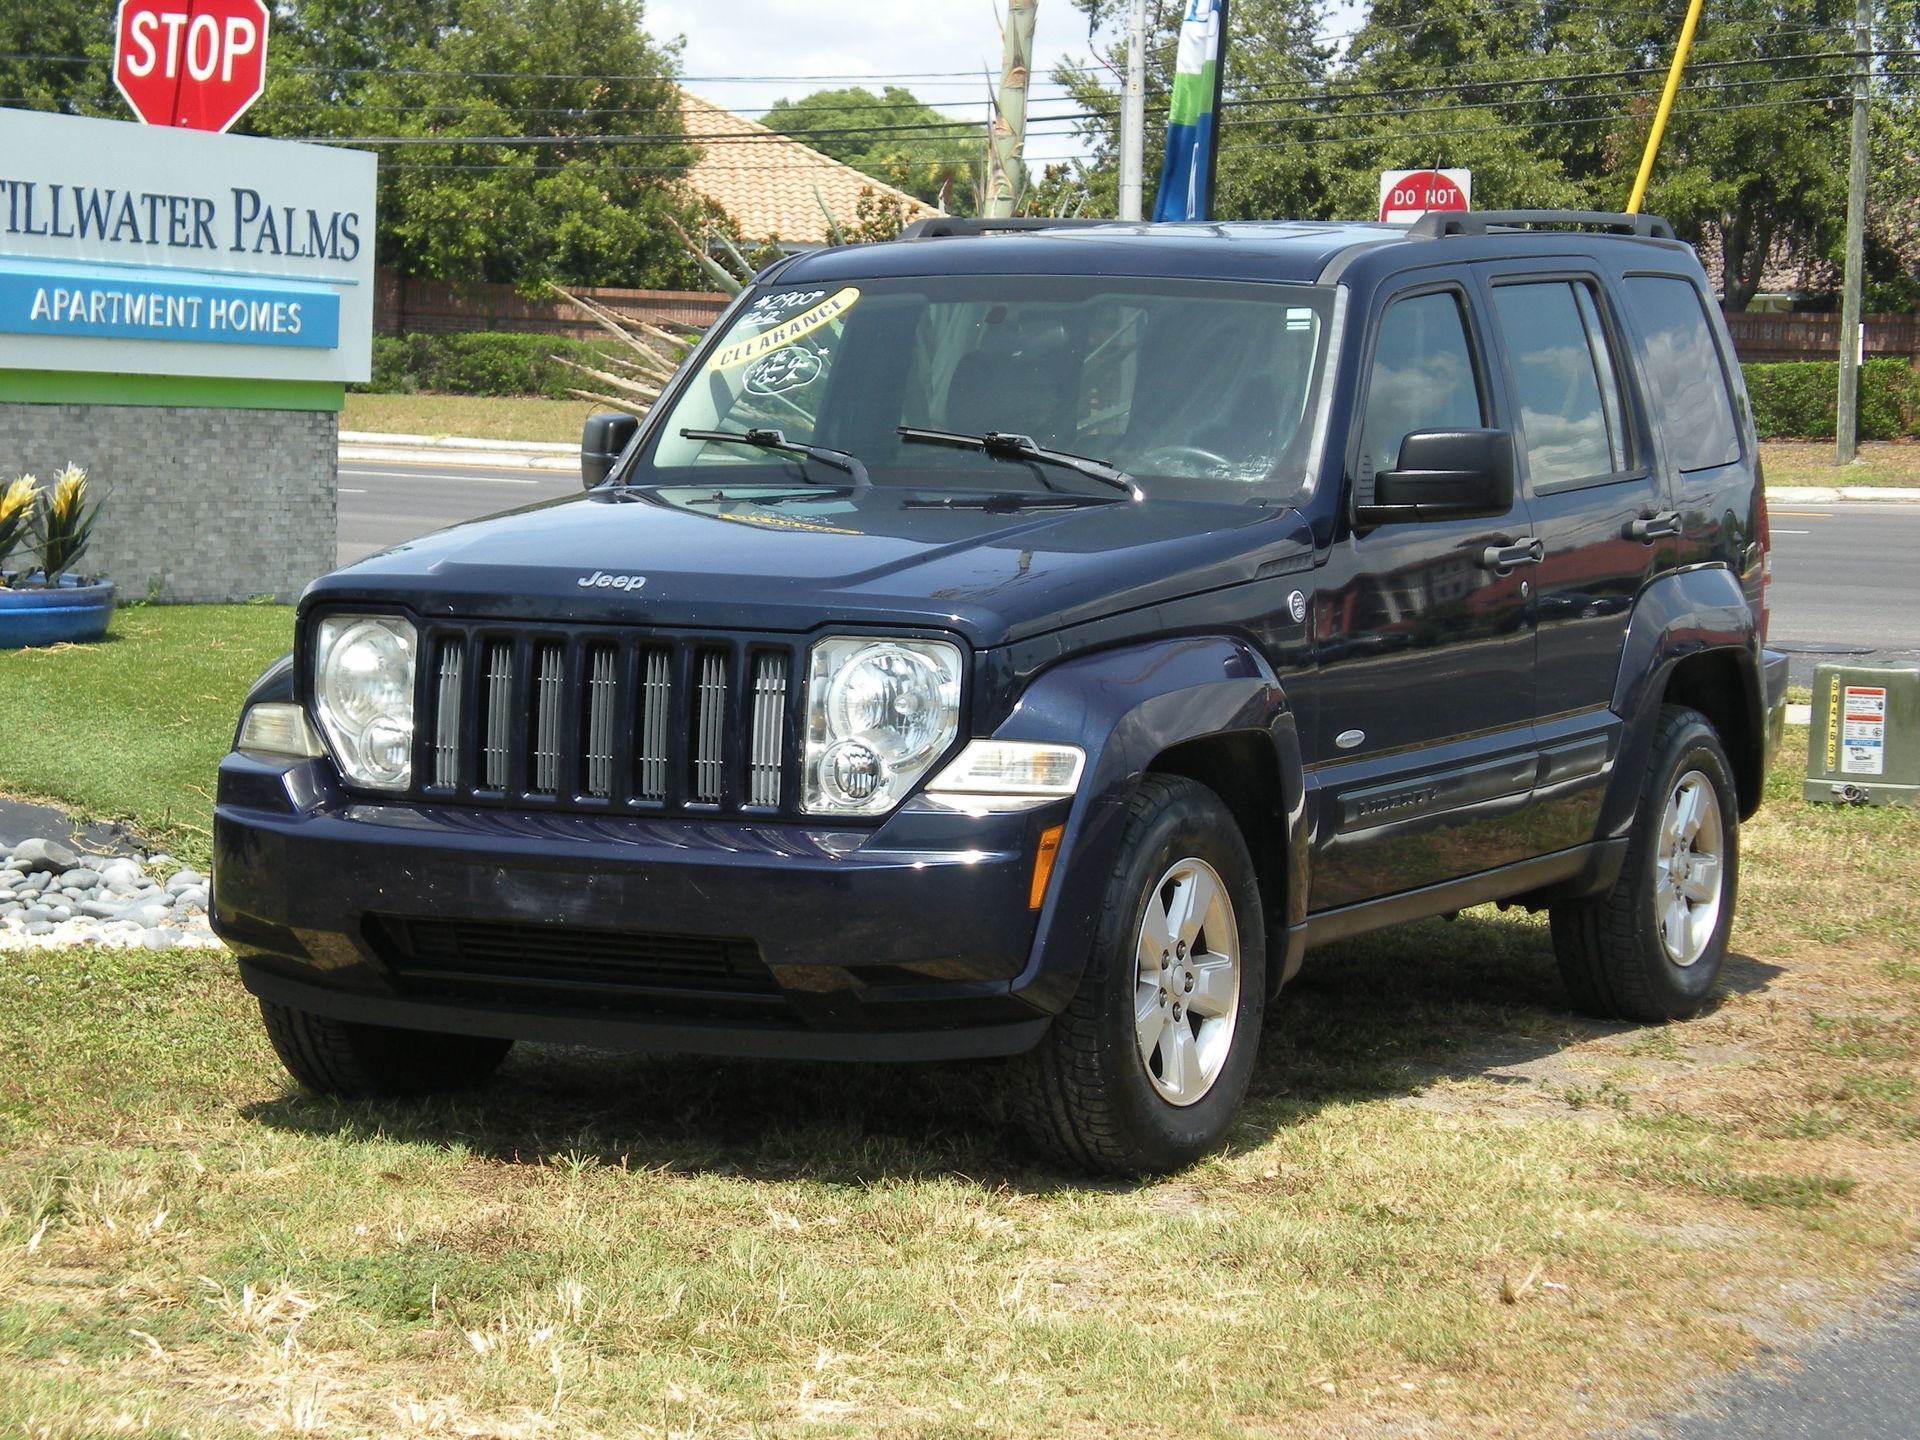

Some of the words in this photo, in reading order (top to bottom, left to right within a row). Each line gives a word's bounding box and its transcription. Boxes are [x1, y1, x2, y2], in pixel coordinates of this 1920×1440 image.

[126, 10, 257, 82] STOP
[1394, 189, 1416, 205] DO
[1425, 188, 1457, 205] NOT
[229, 187, 360, 262] PALMS
[30, 287, 203, 330] APARTMENT
[209, 298, 302, 335] HOMES
[577, 571, 646, 592] Jeep
